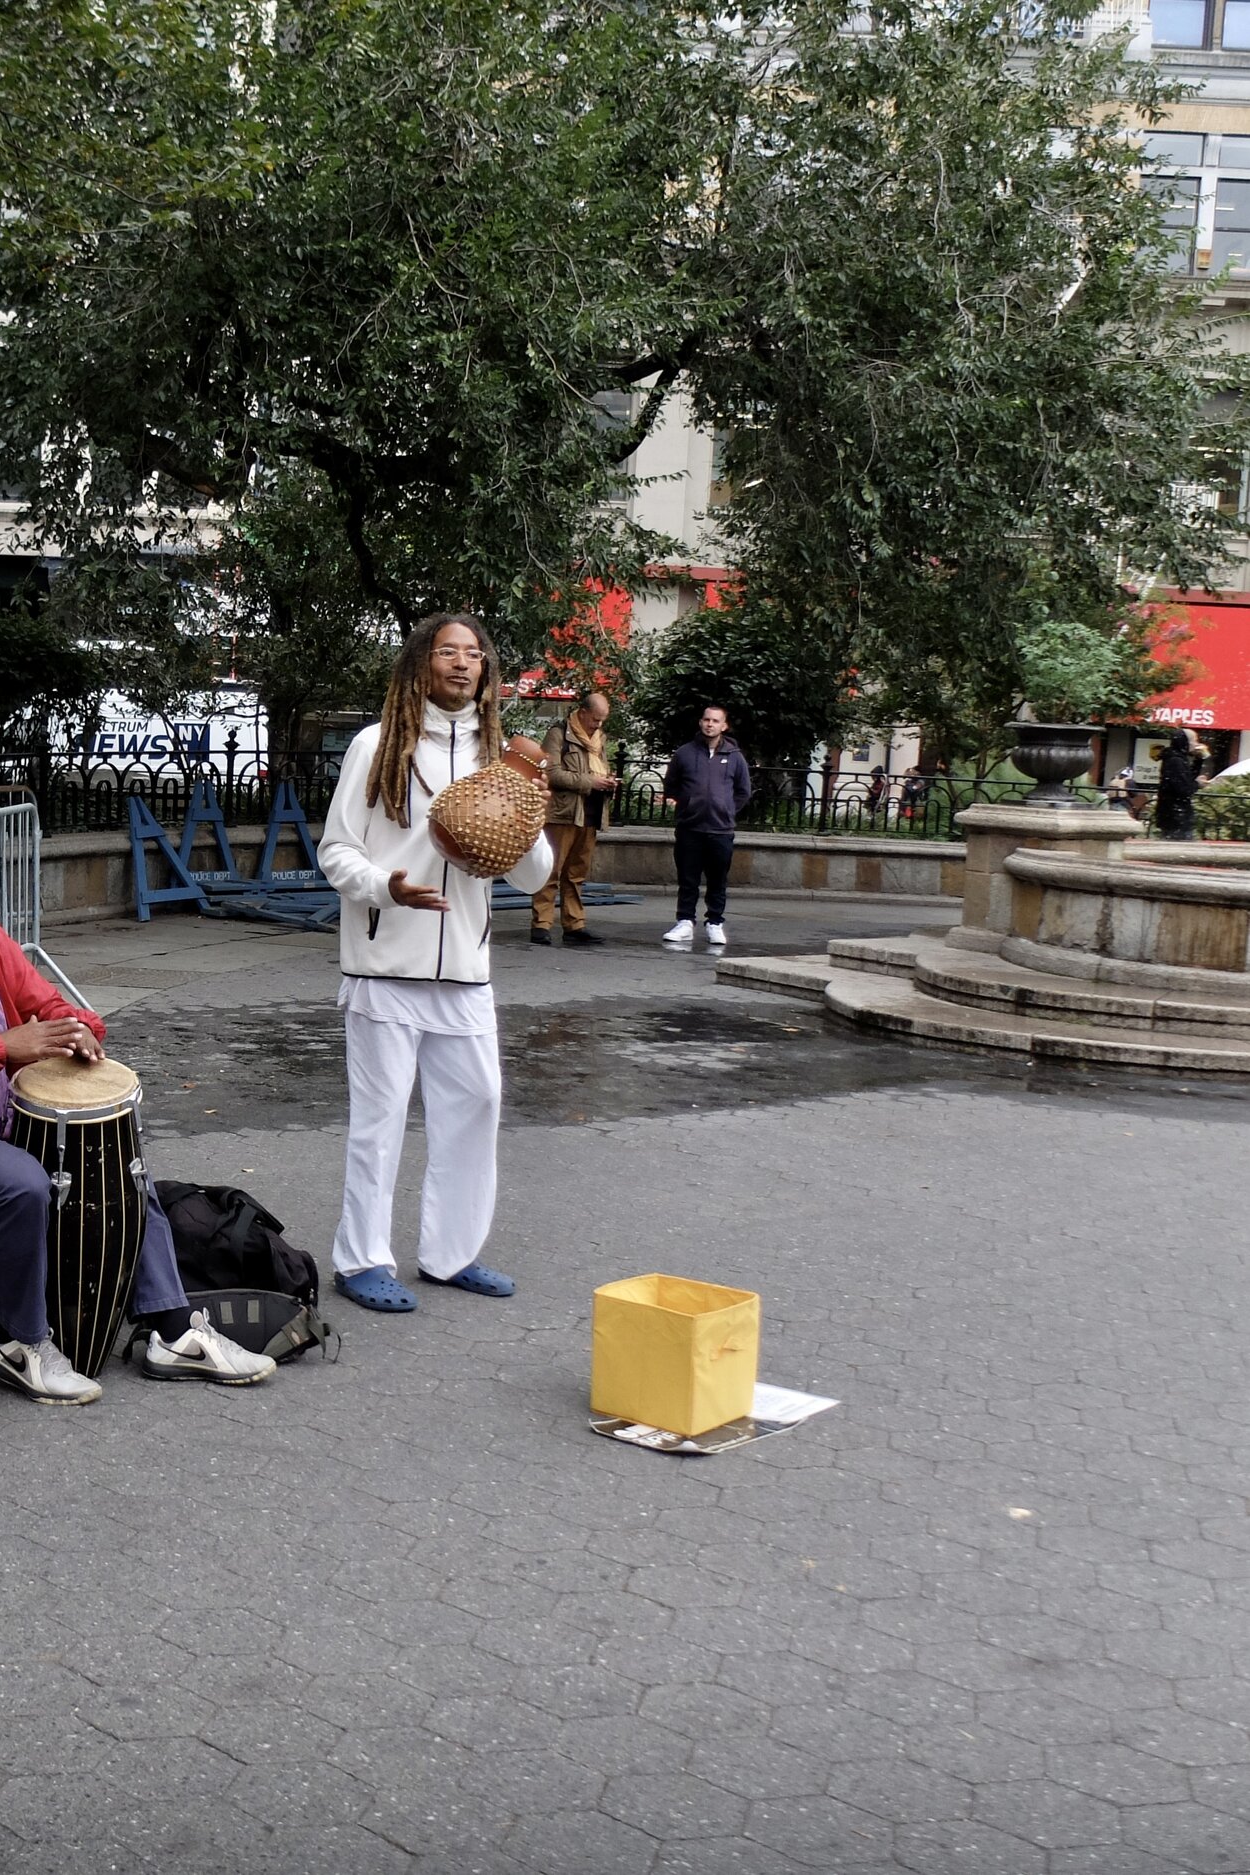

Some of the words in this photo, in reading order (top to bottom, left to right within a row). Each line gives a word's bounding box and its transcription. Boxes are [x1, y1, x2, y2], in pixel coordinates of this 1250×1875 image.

[1147, 707, 1214, 725] TAPLES
[271, 871, 296, 881] POLICE
[298, 870, 317, 880] DEPT
